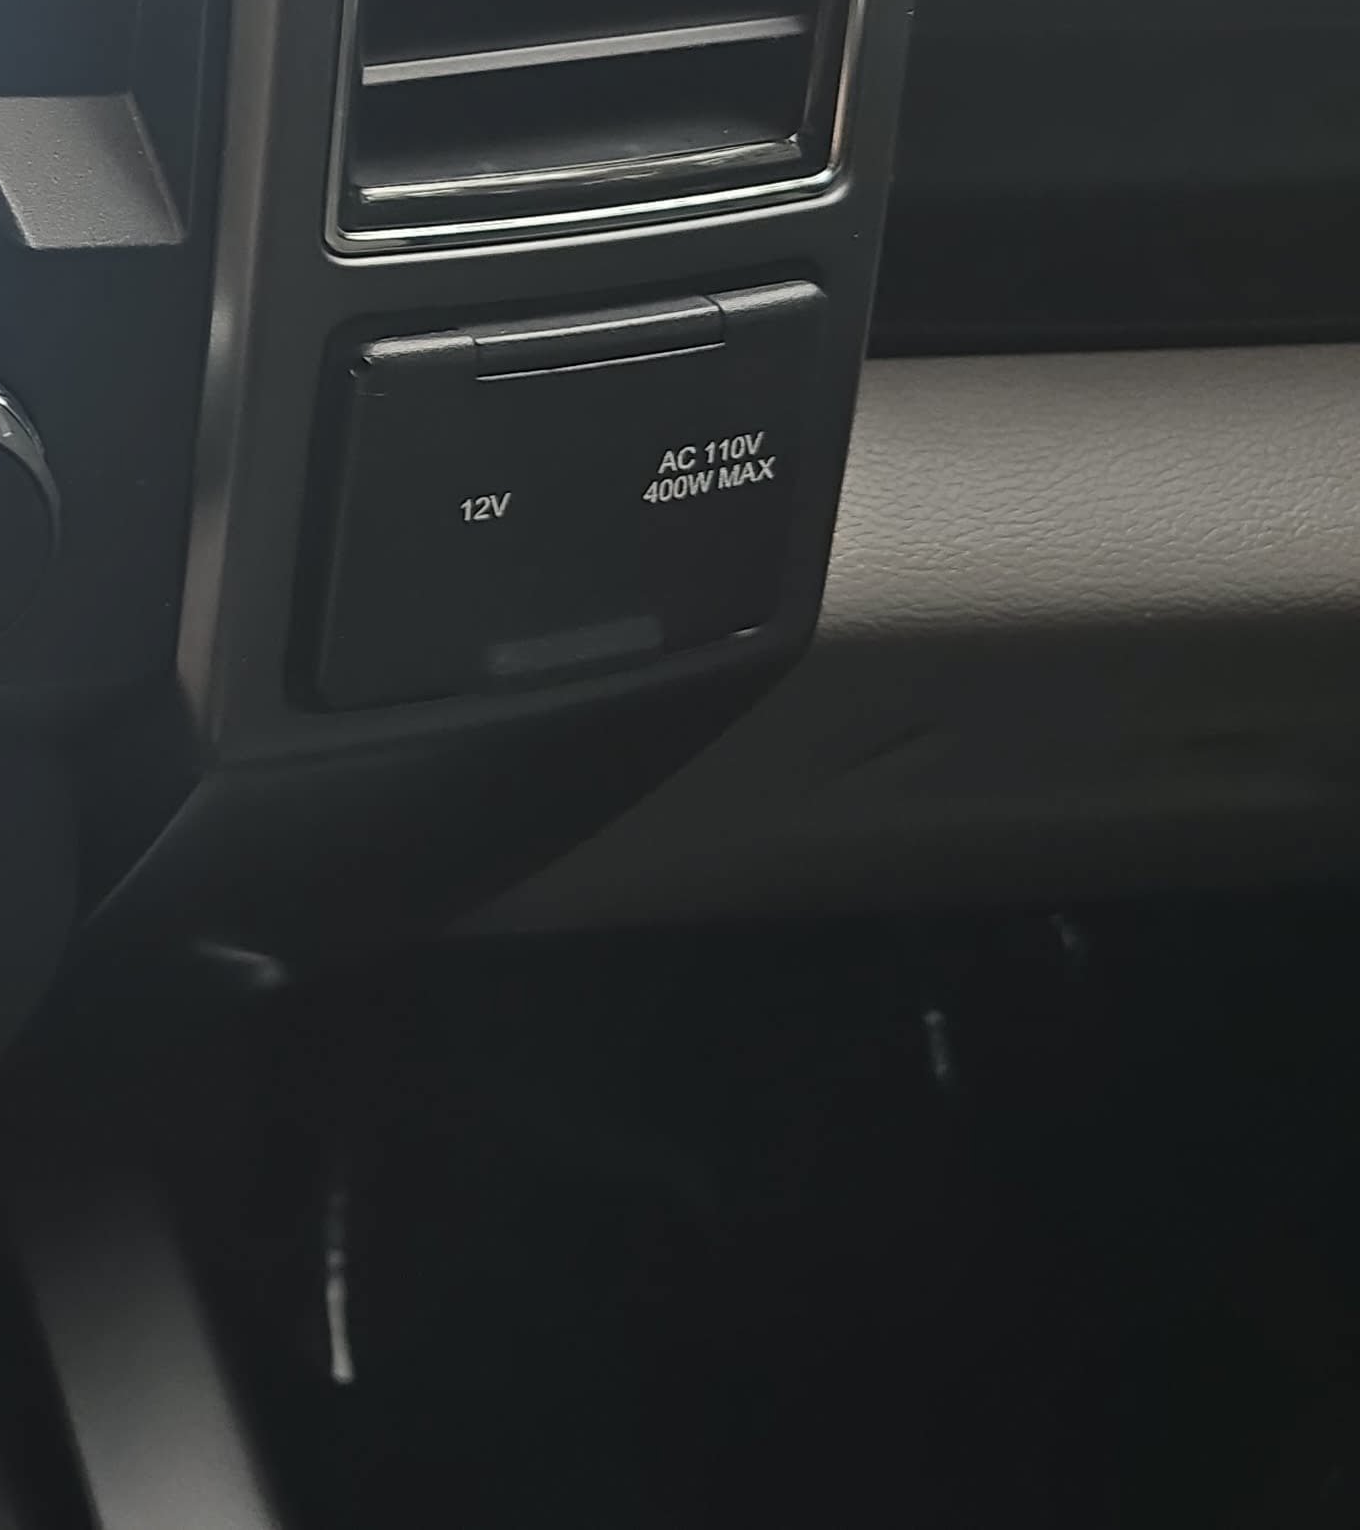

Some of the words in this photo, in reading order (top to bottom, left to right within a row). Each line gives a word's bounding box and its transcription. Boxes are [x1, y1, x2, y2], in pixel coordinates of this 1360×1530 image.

[658, 446, 697, 474] AC
[704, 431, 765, 465] 110V
[643, 471, 713, 504] 400W
[717, 455, 777, 490] MAX
[459, 492, 512, 522] 12V
